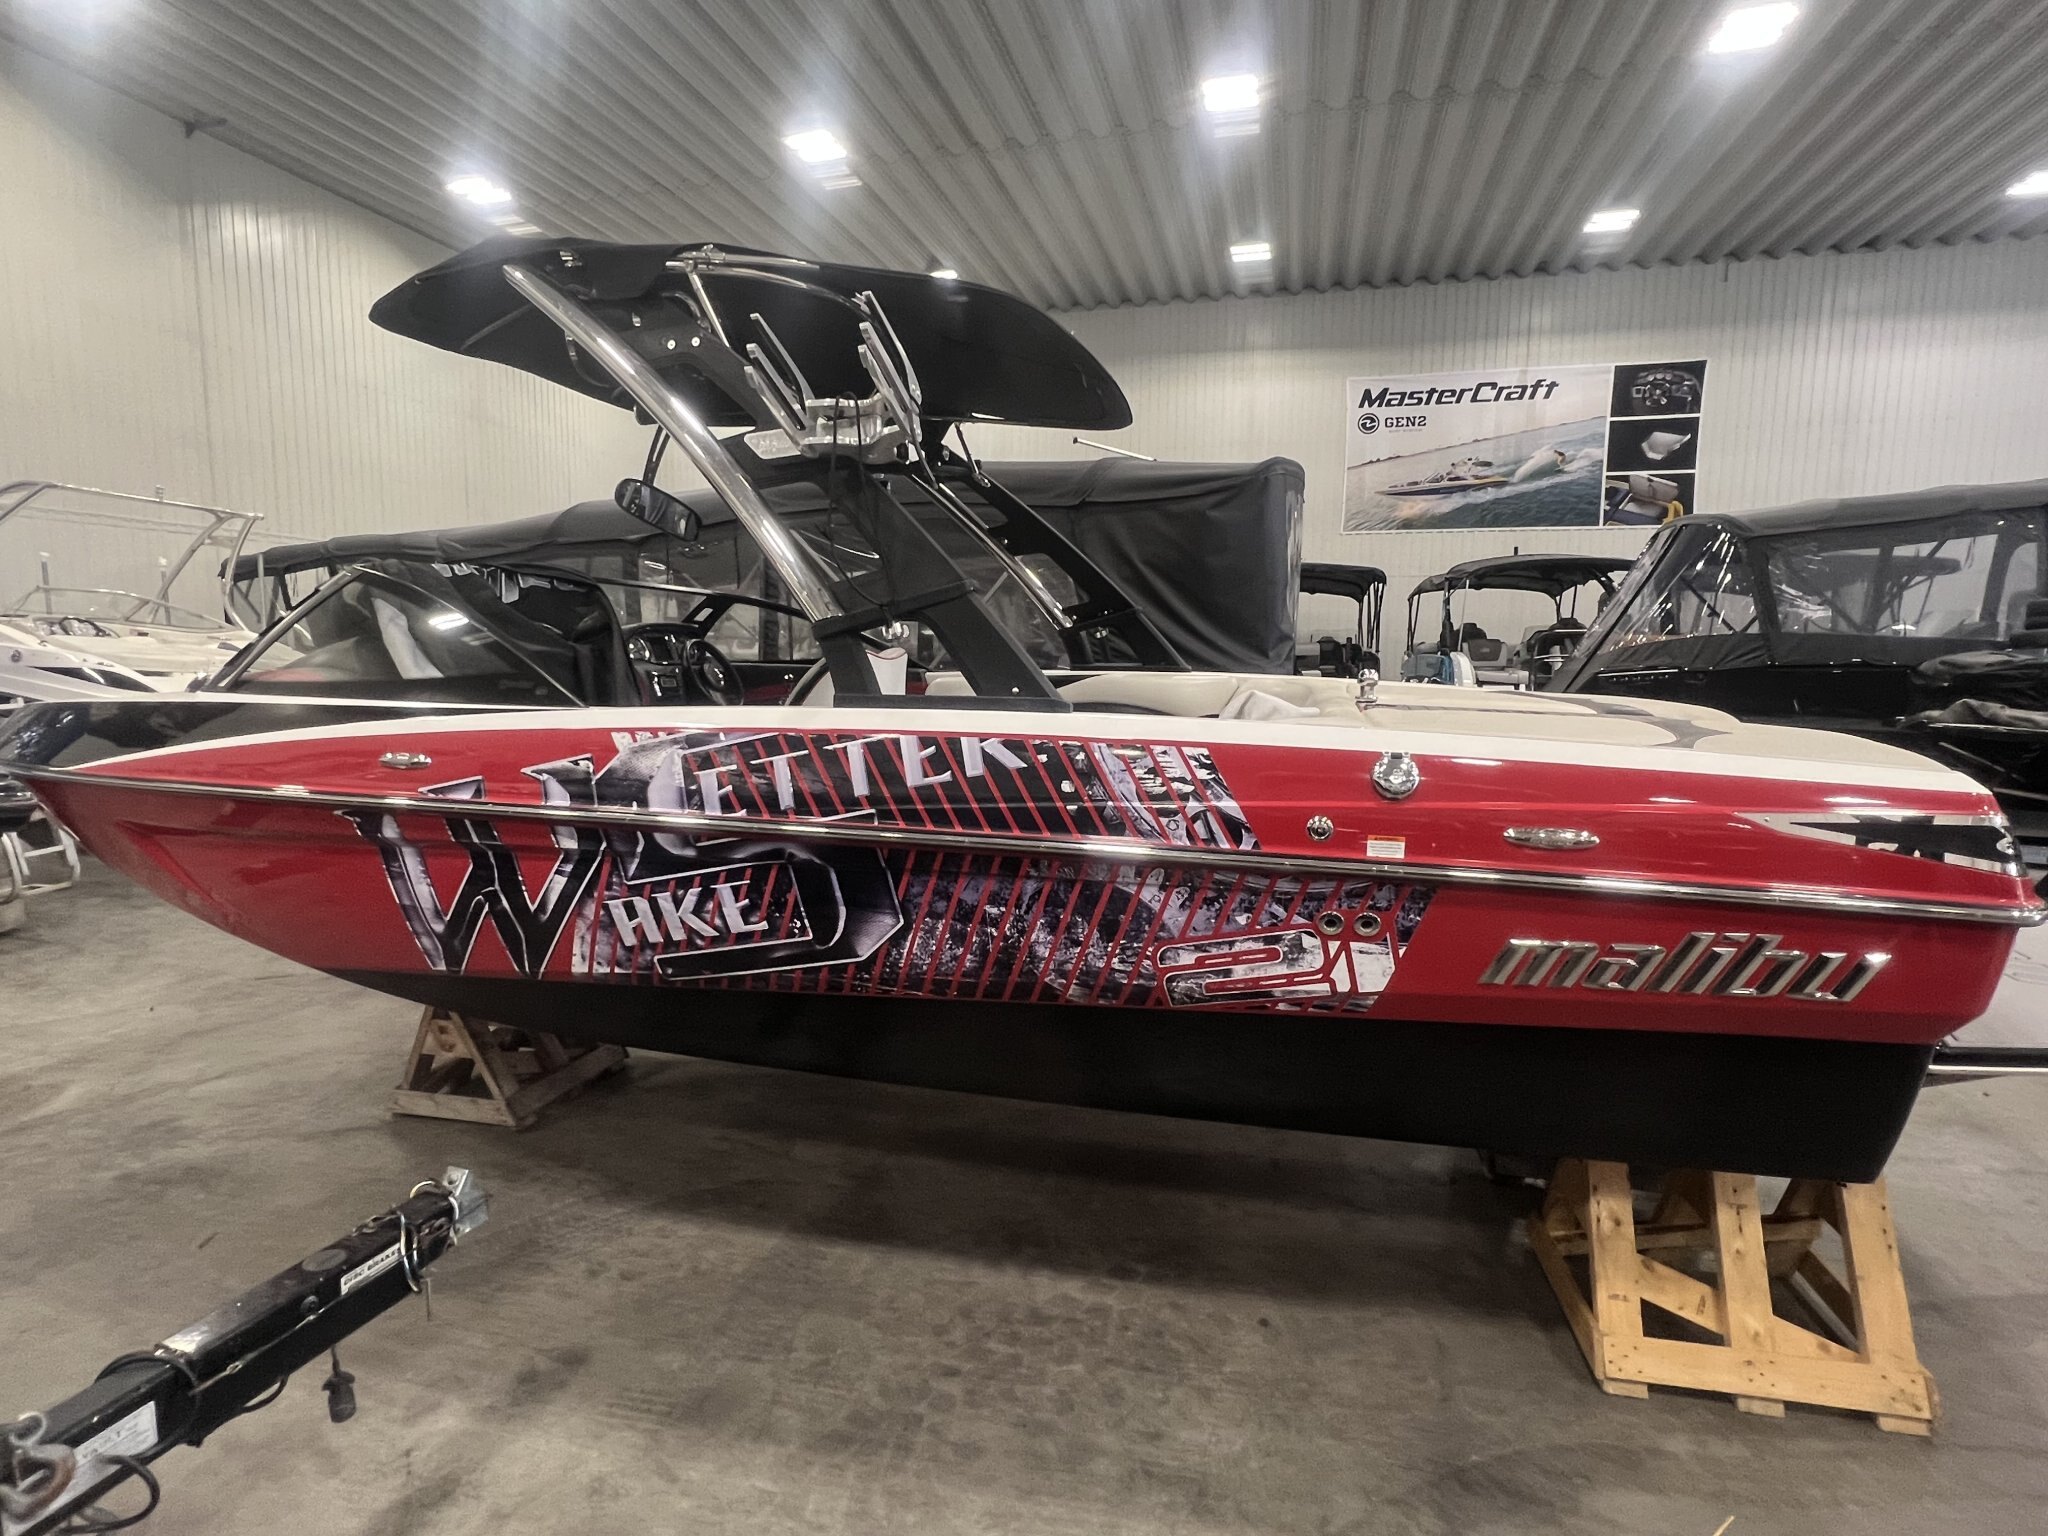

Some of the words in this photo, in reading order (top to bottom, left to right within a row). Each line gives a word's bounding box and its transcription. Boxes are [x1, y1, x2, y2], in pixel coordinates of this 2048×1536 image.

[1358, 378, 1560, 409] MasterCraft
[1384, 415, 1427, 429] GEN2
[1478, 931, 1892, 1002] malibu
